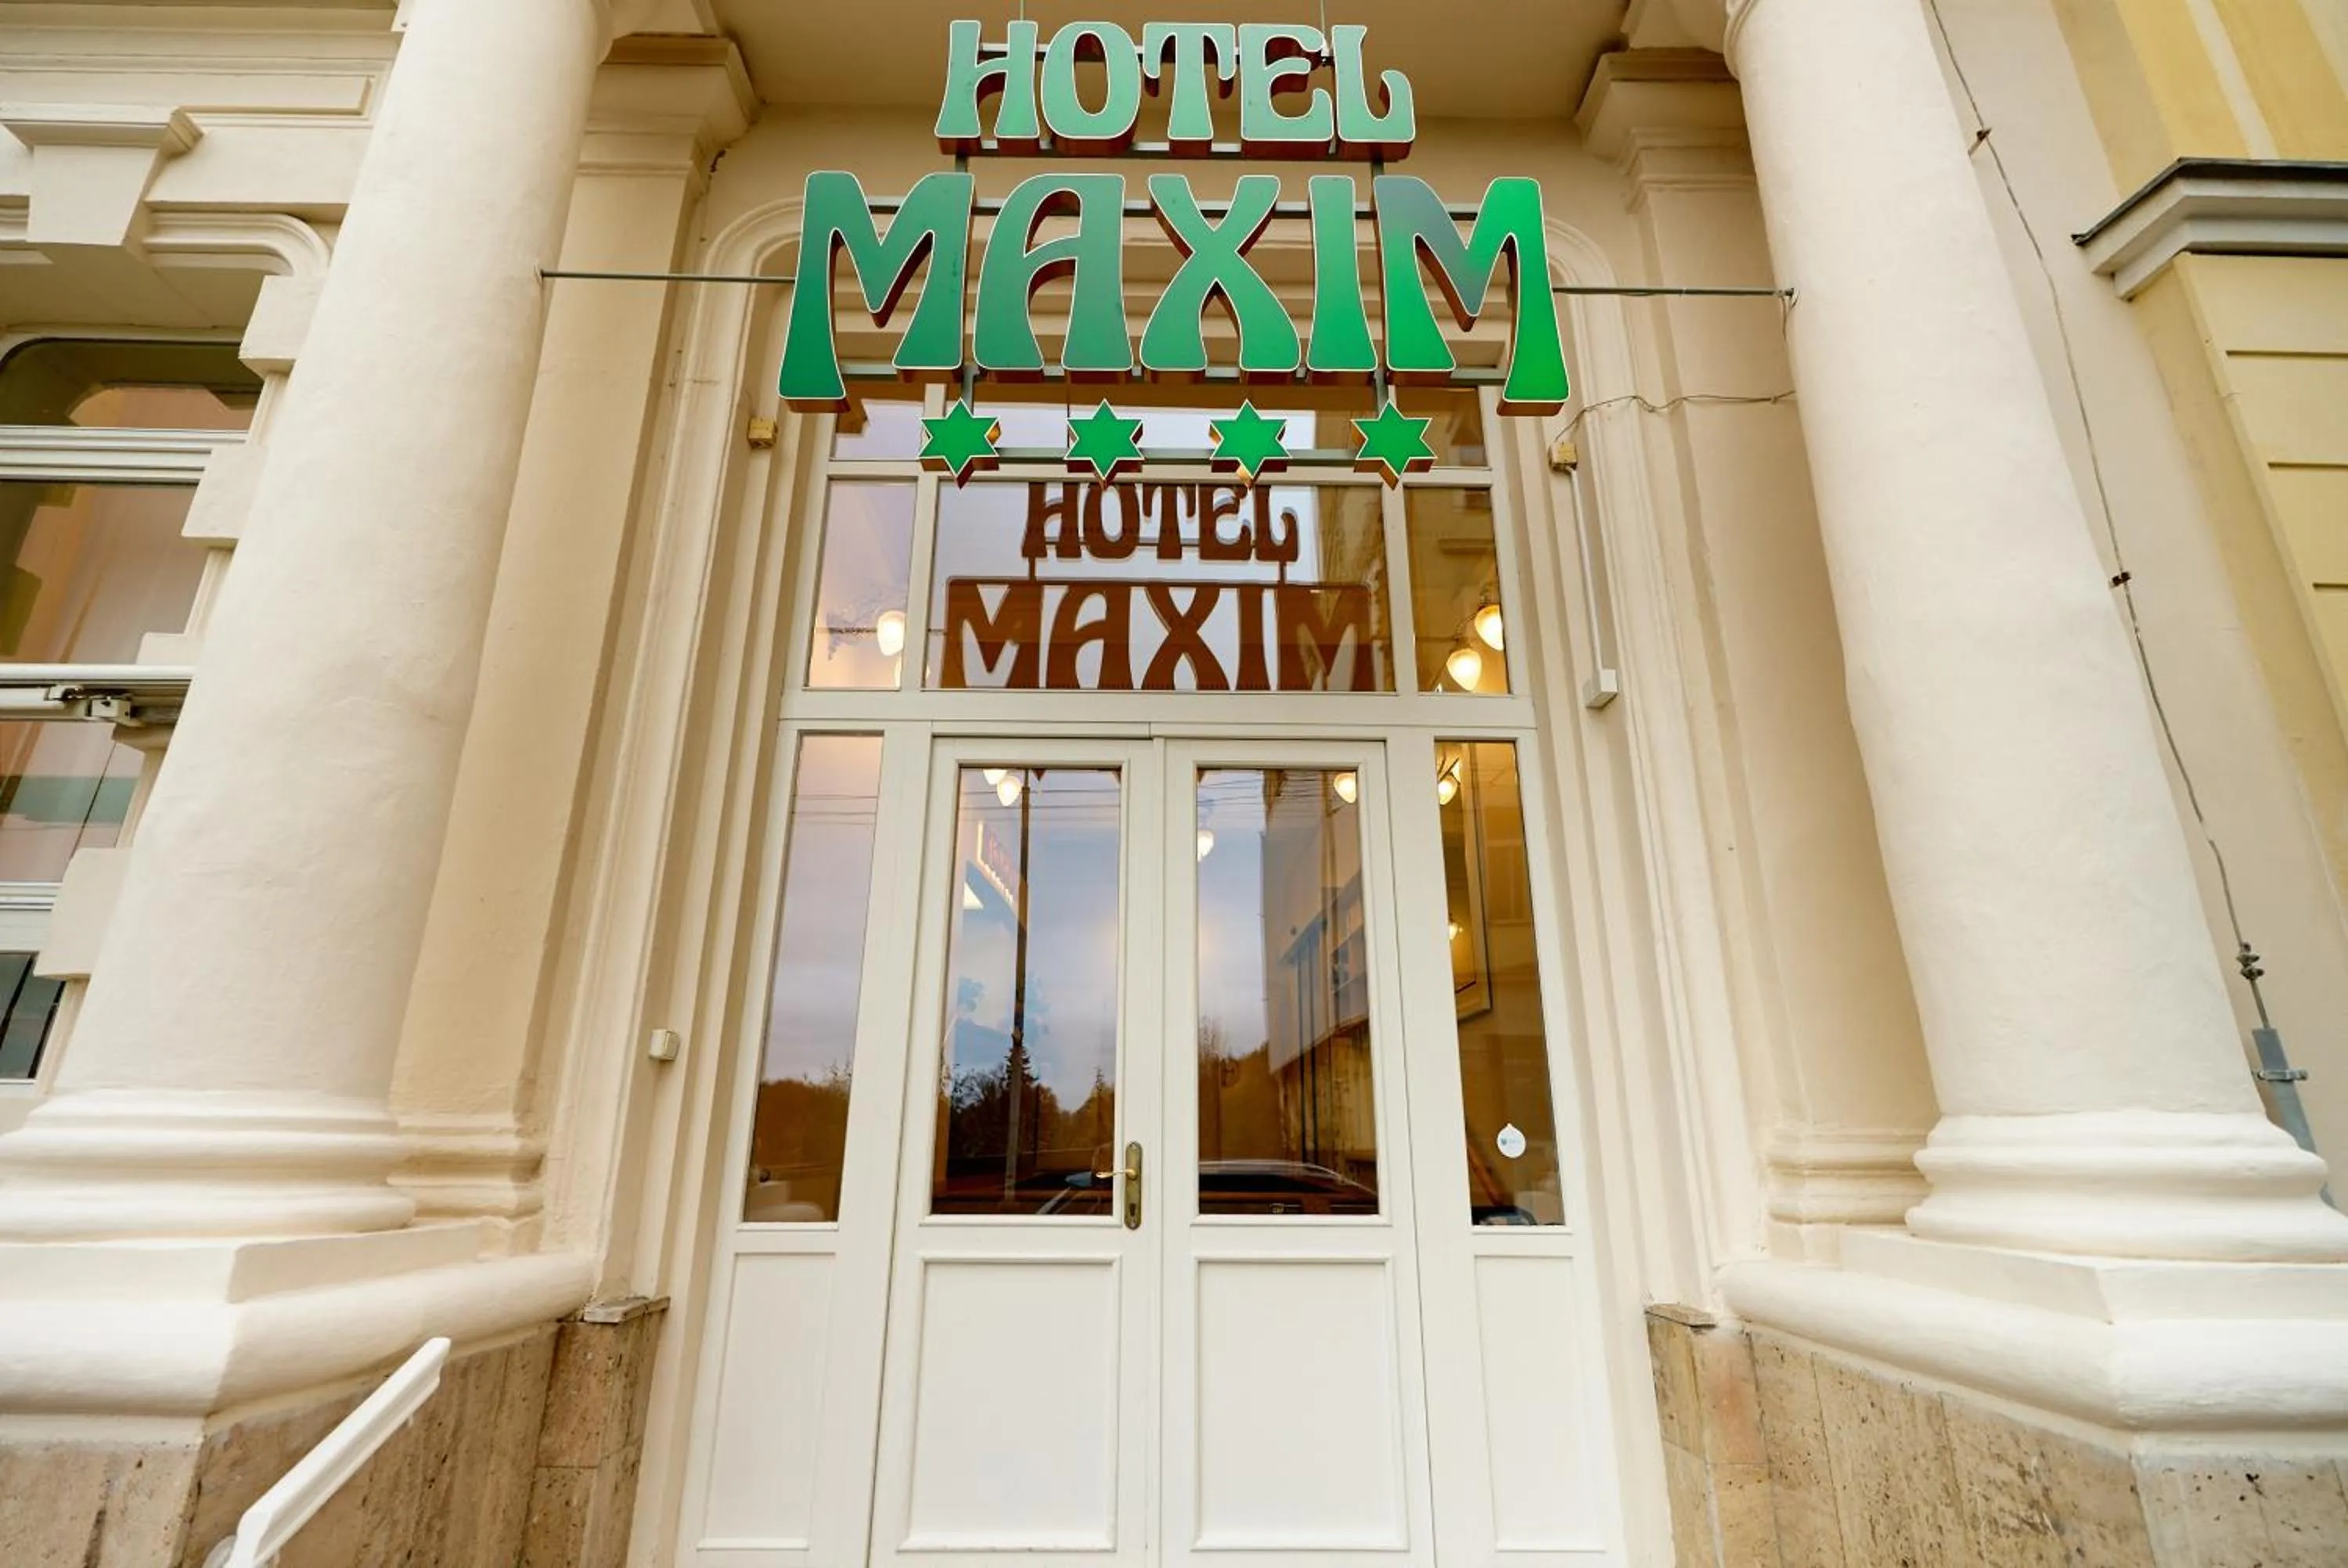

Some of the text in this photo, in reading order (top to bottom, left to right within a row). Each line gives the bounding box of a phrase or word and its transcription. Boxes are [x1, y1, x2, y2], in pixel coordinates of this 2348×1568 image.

[935, 20, 1415, 142] HOTEL
[777, 170, 1569, 405] MAXIM
[1021, 482, 1299, 562] HOTEL
[941, 581, 1375, 690] MAXIM
